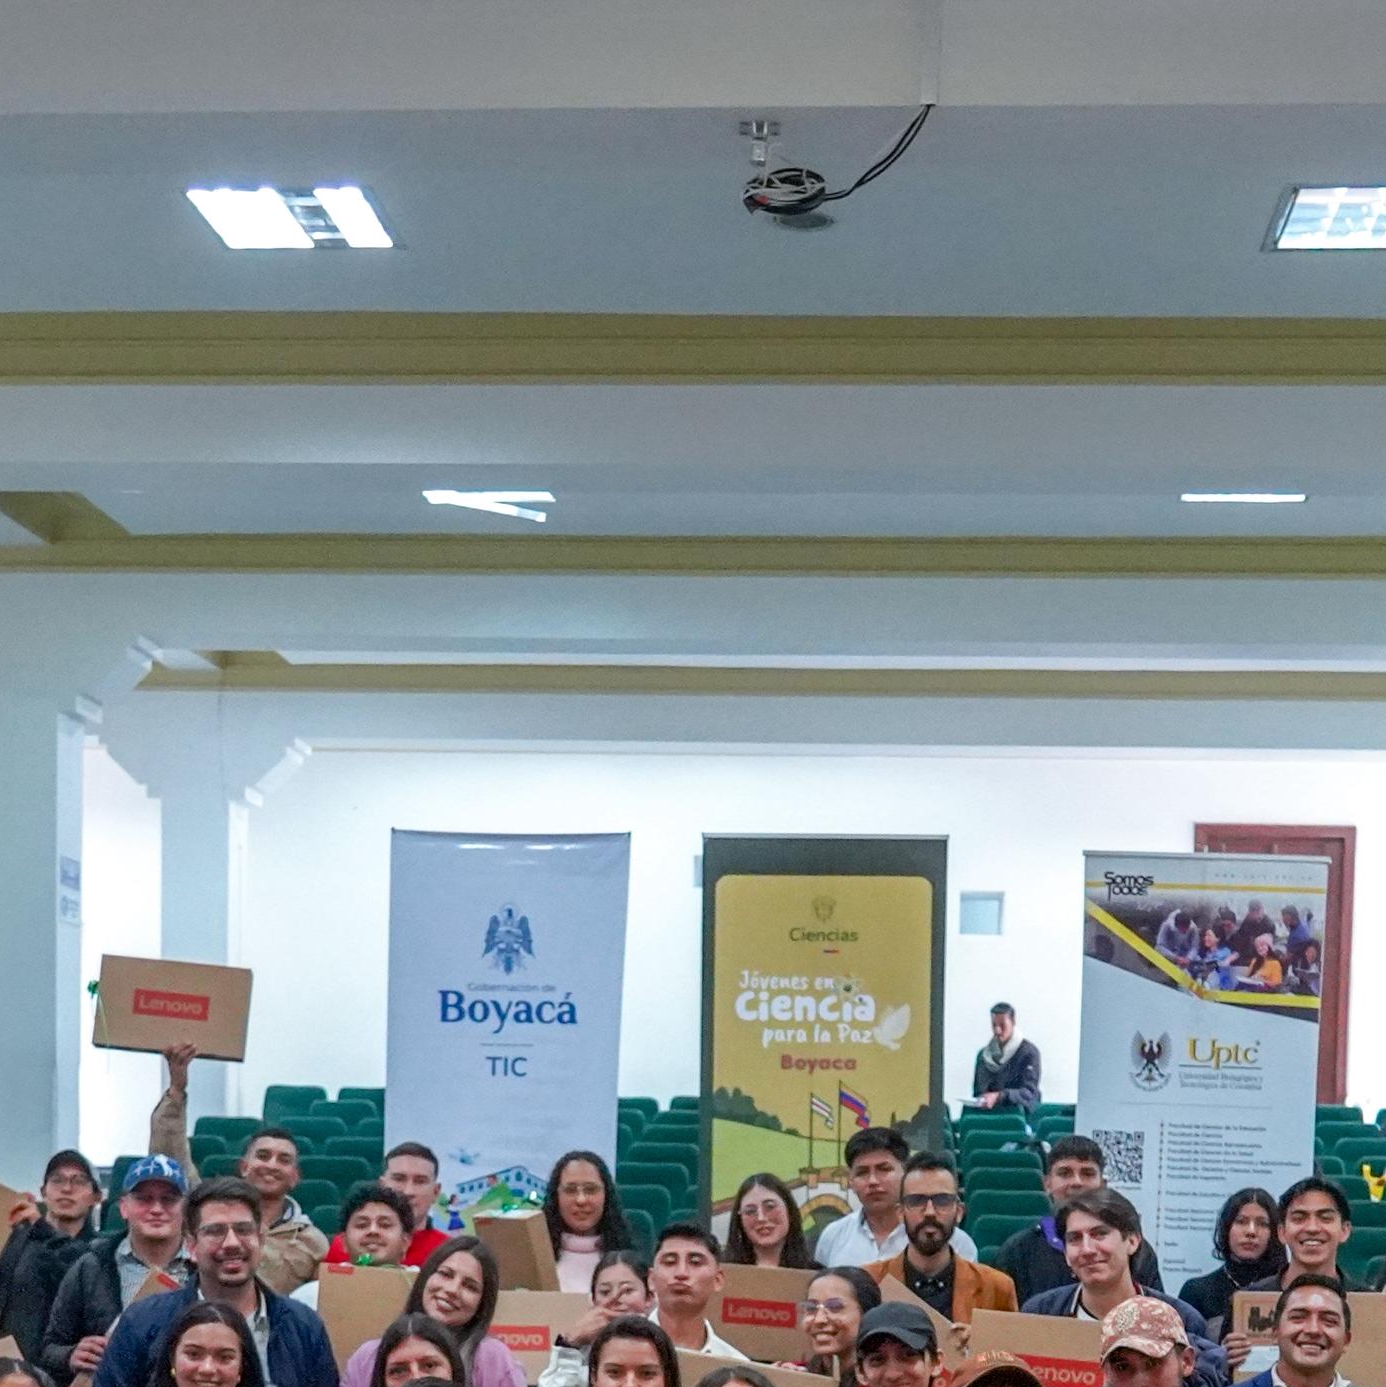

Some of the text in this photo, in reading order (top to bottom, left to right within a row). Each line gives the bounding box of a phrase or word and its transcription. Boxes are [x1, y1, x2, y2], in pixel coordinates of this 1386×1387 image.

[1104, 872, 1154, 887] Somos
[790, 927, 859, 942] Ciencias
[739, 969, 835, 990] Jóvenes en
[139, 994, 203, 1014] Lenovo
[438, 989, 578, 1034] Boyacá
[735, 990, 876, 1022] Ciencia
[762, 1023, 874, 1048] para la Paz
[1188, 1038, 1258, 1070] Uptc
[485, 1056, 527, 1077] TIC
[728, 1303, 791, 1321] Lenovo
[1033, 1365, 1096, 1386] enovo
